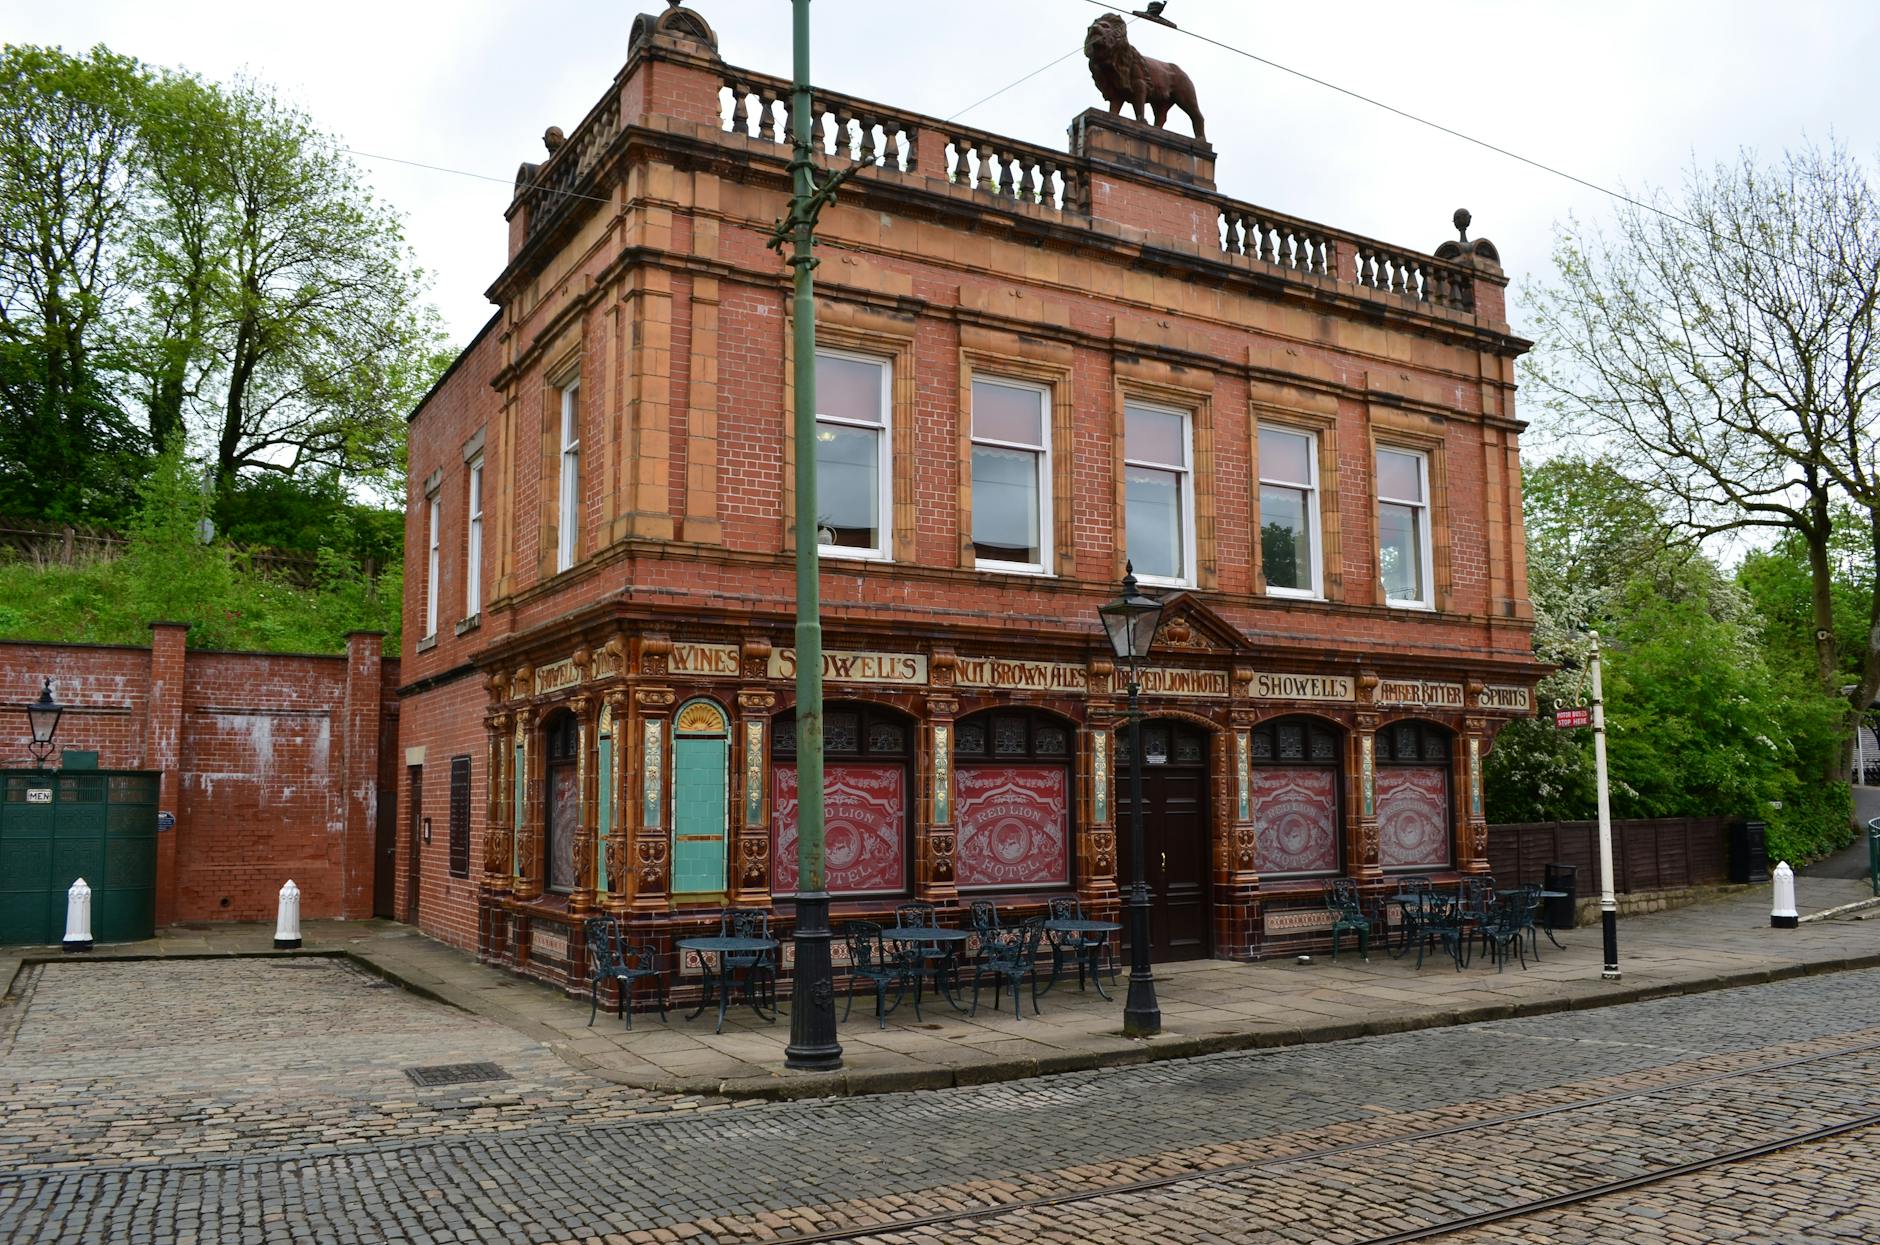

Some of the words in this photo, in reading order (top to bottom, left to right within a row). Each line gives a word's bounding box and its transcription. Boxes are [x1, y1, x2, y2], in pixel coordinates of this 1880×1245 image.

[669, 643, 739, 673] WINES
[779, 649, 917, 679] SOWELL'S
[953, 660, 985, 684] NUT
[986, 661, 1048, 688] BROWN
[1048, 664, 1087, 688] ALES
[1136, 669, 1161, 692] RED
[1161, 669, 1190, 692] LION
[1190, 670, 1228, 694] HOTEL
[1258, 674, 1348, 698] SHOWELL'S
[1381, 681, 1420, 705] AMBER
[1420, 682, 1462, 706] BITTER
[1480, 686, 1526, 707] SPIRITS
[30, 792, 49, 800] MEN
[839, 807, 875, 824] LION
[977, 806, 1007, 823] RED
[1009, 806, 1041, 821] LION
[824, 865, 872, 885] OTEL
[982, 859, 1040, 878] HOTEL
